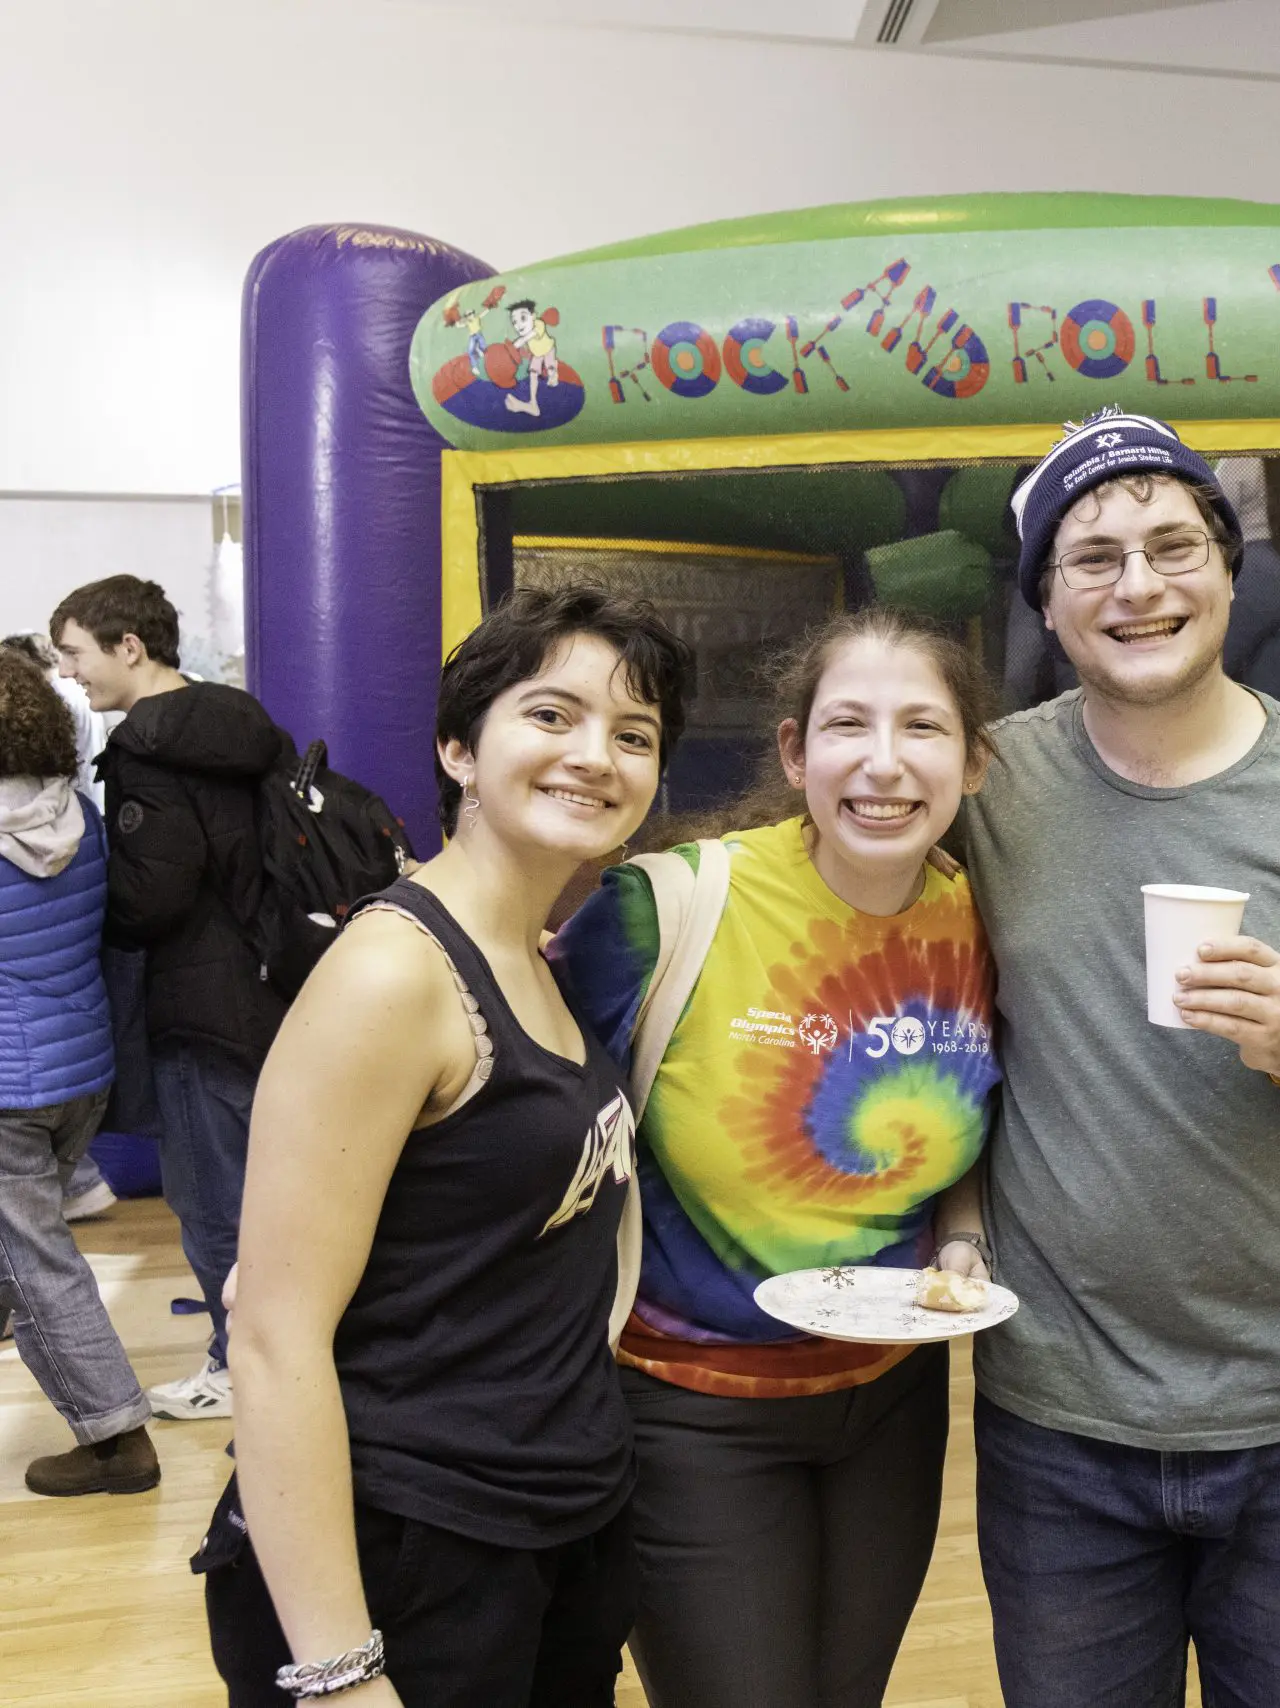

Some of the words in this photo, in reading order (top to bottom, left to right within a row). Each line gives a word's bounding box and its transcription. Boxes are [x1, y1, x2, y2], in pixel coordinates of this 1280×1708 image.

[601, 314, 851, 405] ROCK
[840, 256, 990, 400] AND
[1007, 296, 1259, 386] ROLL
[1063, 456, 1101, 484] Columbia
[1108, 446, 1147, 458] Barnard
[1064, 482, 1074, 492] The
[1088, 462, 1106, 475] Center
[1106, 458, 1117, 467] for
[1118, 454, 1138, 465] Jewish
[1138, 454, 1161, 462] Student
[728, 1031, 756, 1042] North
[758, 1035, 796, 1048] Carolina
[729, 1017, 796, 1036] Olympics
[865, 1016, 926, 1058] 50
[927, 1020, 988, 1039] YEARS
[931, 1041, 989, 1054] 1968-2018
